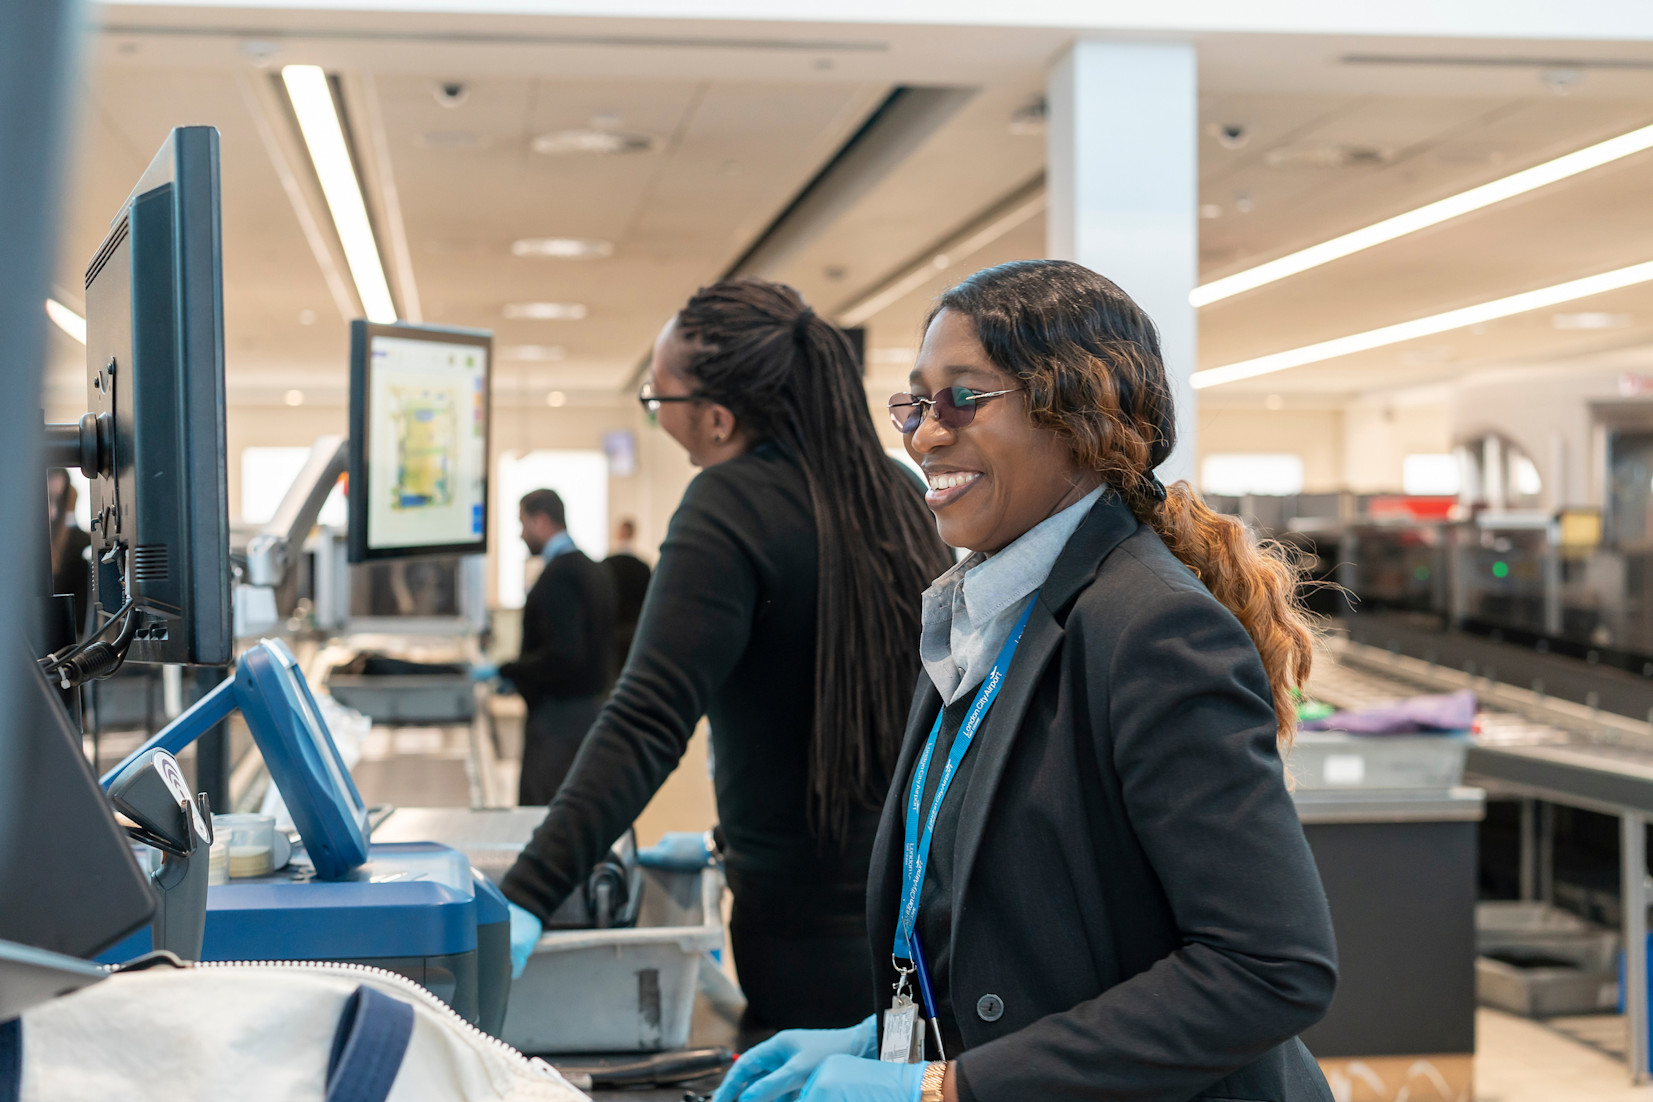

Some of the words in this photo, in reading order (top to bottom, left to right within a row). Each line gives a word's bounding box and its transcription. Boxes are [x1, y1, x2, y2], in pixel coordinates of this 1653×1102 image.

[963, 709, 980, 737] London
[976, 694, 988, 710] City
[984, 671, 1003, 697] Airport
